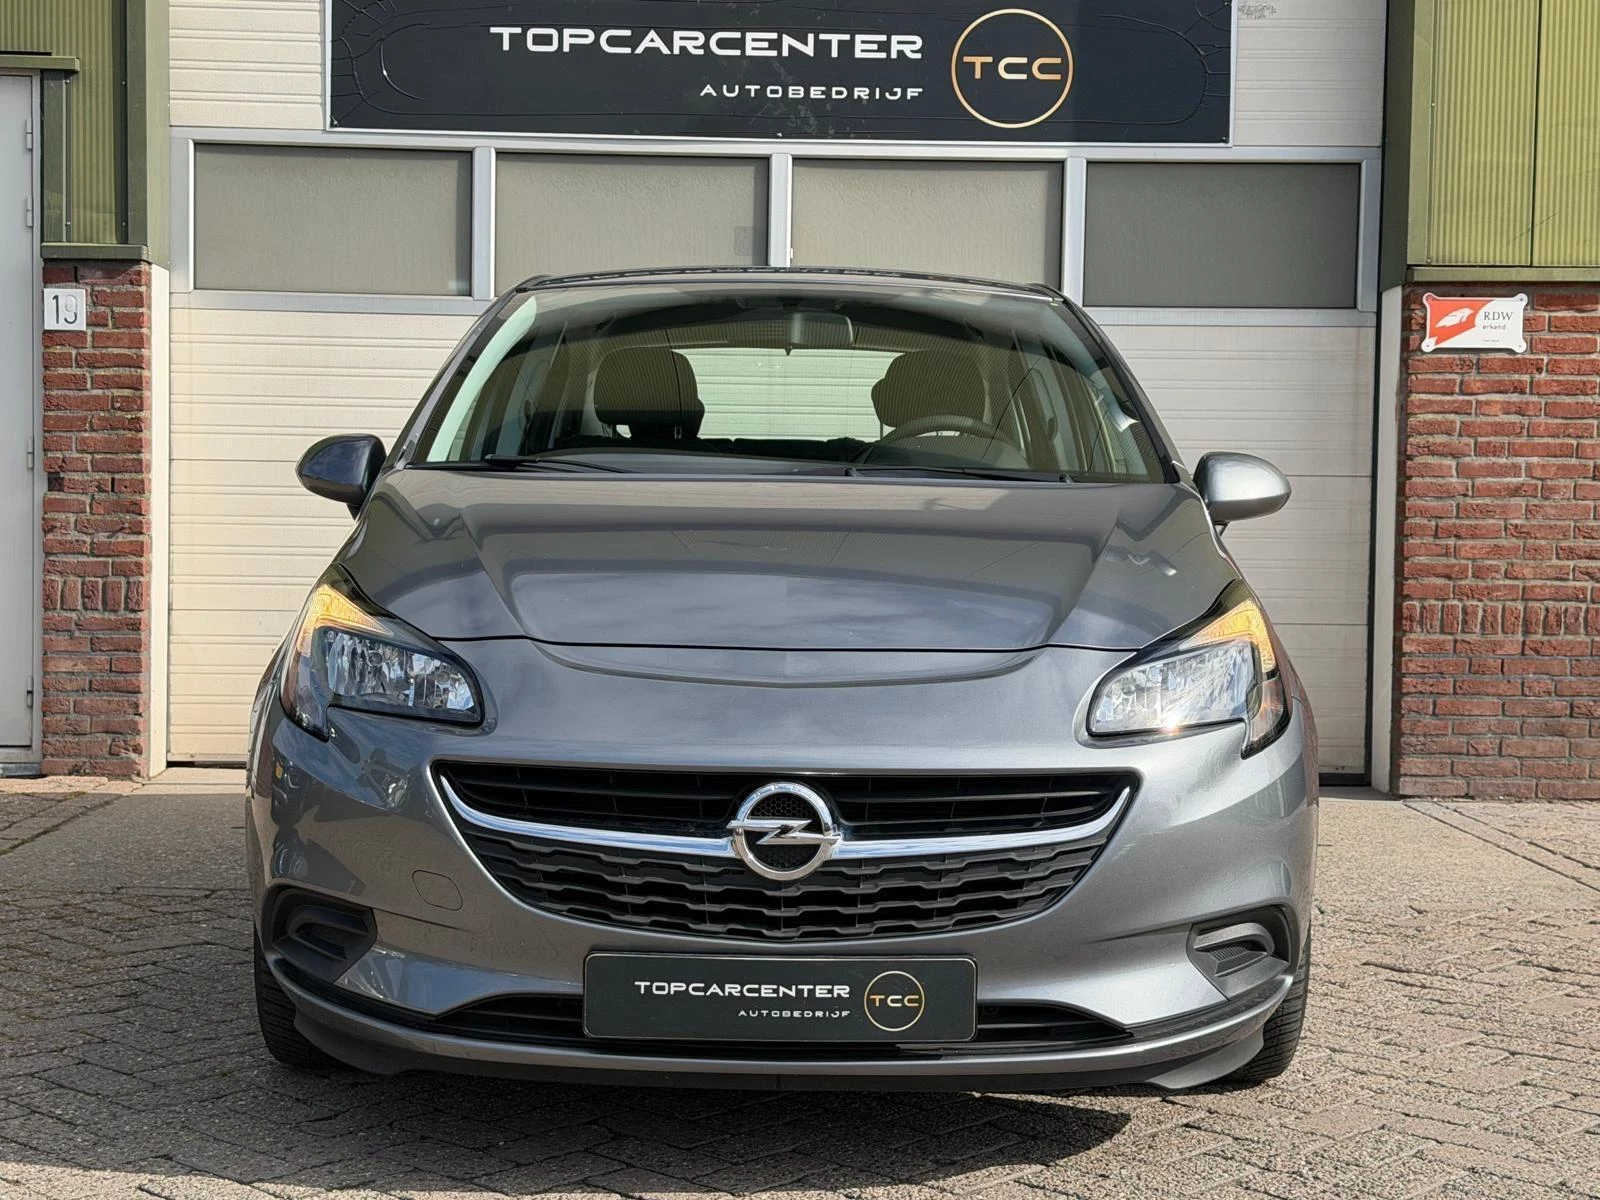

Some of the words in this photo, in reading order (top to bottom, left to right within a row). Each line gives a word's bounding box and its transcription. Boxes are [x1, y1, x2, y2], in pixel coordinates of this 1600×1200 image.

[489, 26, 923, 60] TOPCARCENTER
[962, 55, 1063, 80] TCC
[700, 83, 924, 101] AUTOBEDRIJF
[51, 293, 78, 325] 19
[1483, 311, 1514, 321] RDW
[634, 980, 851, 999] TOPCARCENTER
[869, 994, 920, 1007] TCC
[737, 1009, 851, 1018] AUTOBEDRIJF
